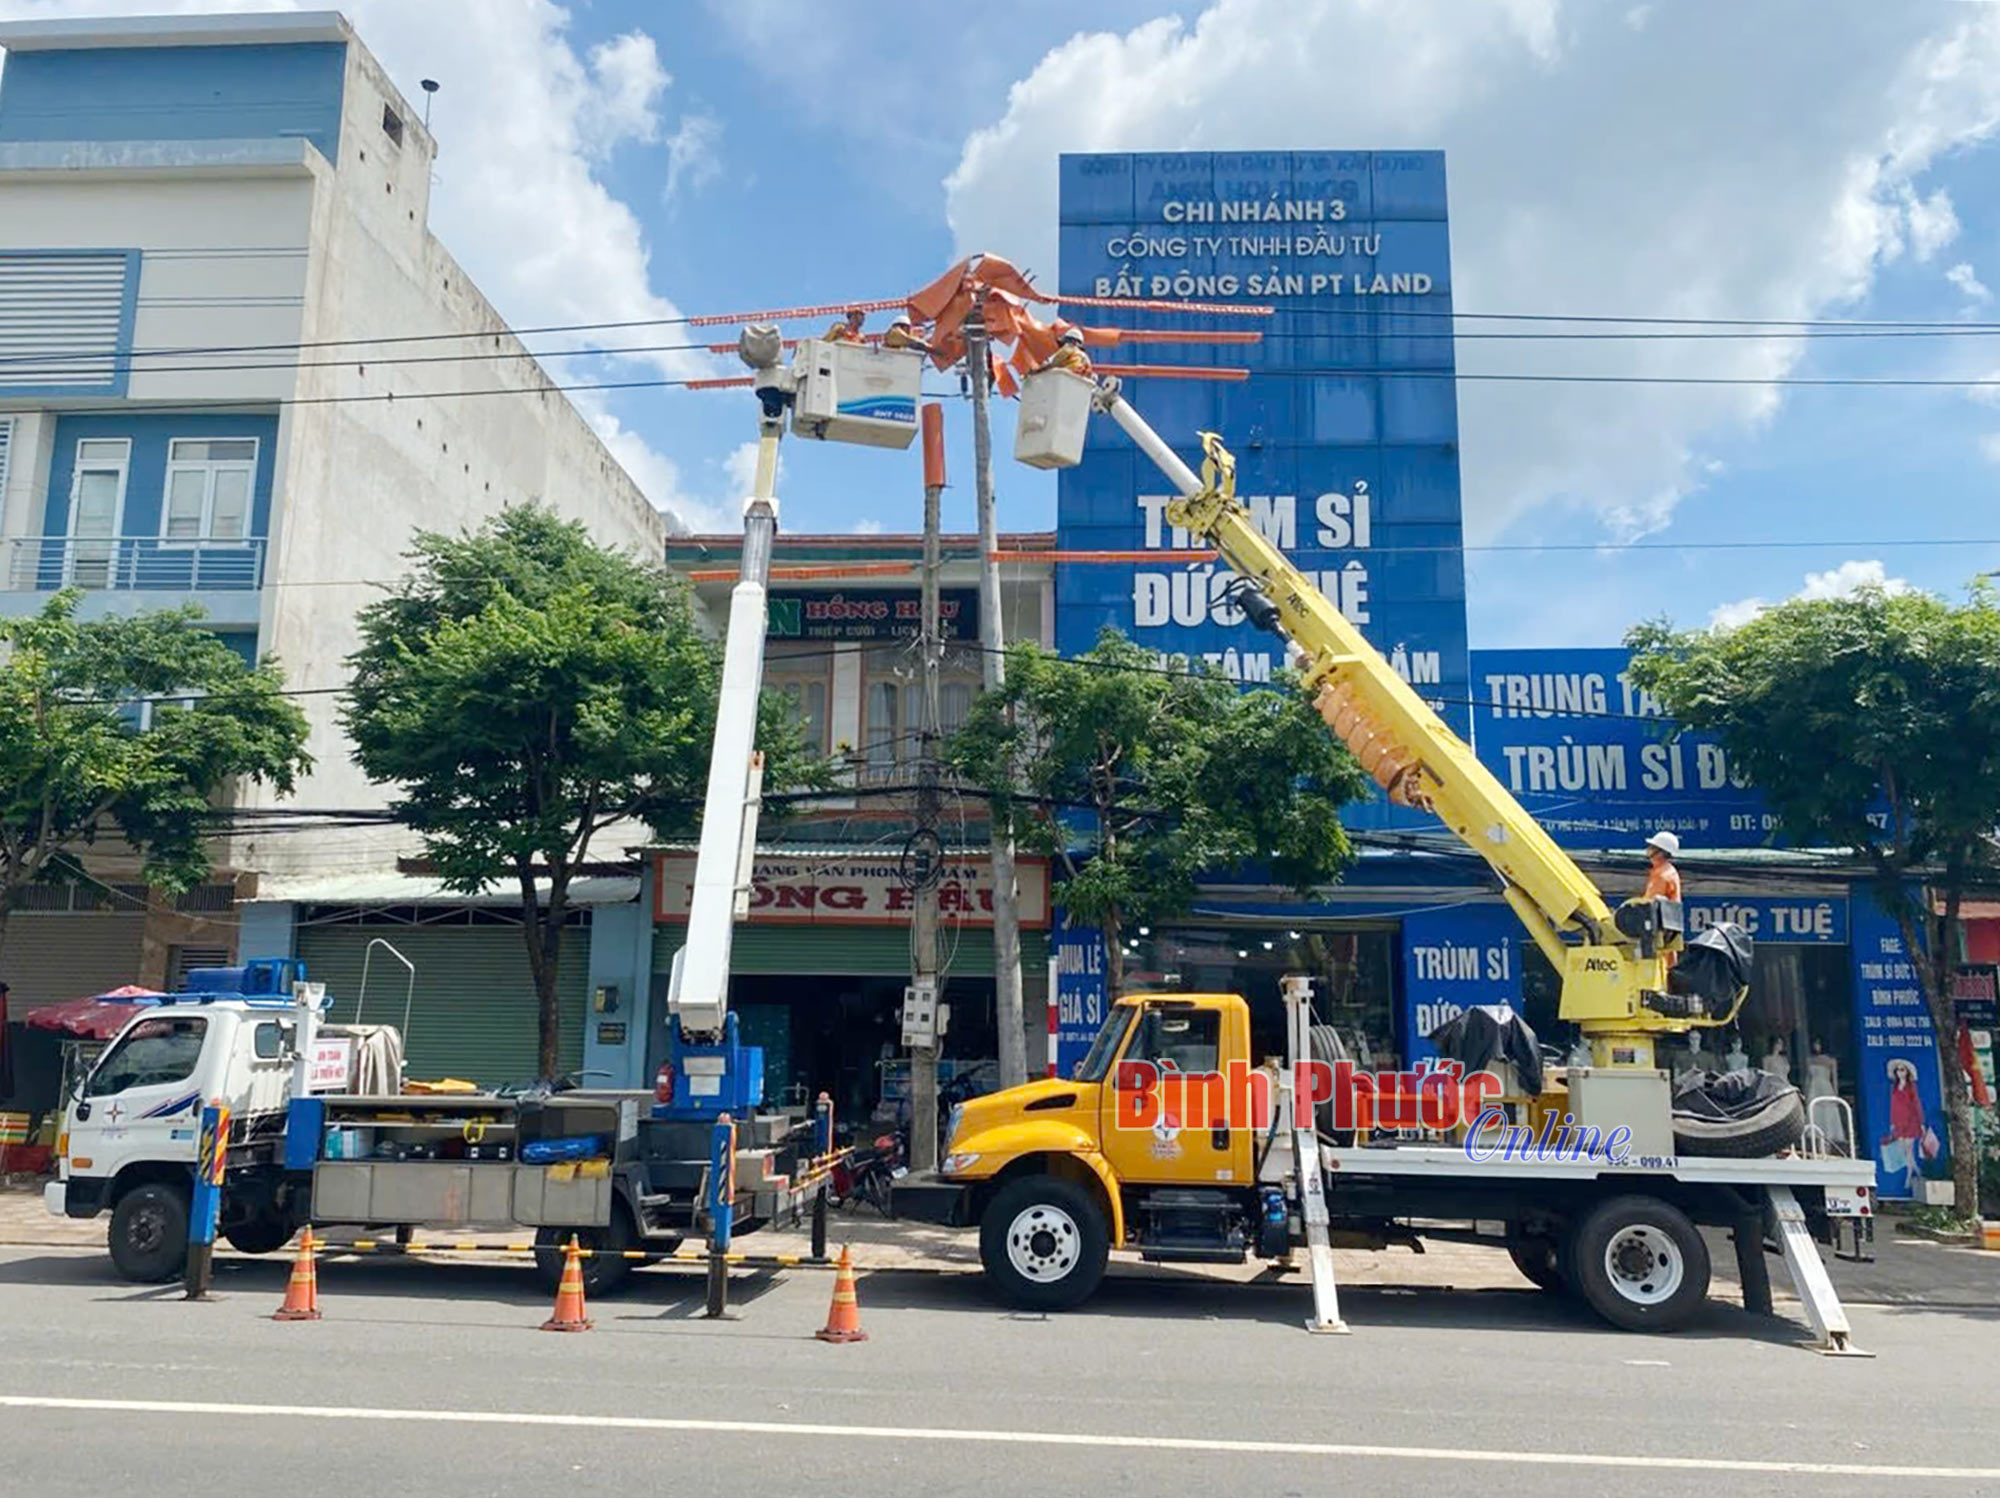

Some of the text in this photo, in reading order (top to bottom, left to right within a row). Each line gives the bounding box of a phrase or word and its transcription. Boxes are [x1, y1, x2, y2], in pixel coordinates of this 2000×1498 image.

[1163, 192, 1346, 223] CHI NHÁNH 3
[1107, 225, 1381, 258] CÔNG TY TNHH ĐẦU TƯ
[1095, 265, 1433, 303] BẤT ĐỘNG SẢN PT LAND
[1315, 481, 1371, 549] SỈ
[806, 593, 889, 619] HỒNG
[1380, 642, 1440, 684] ẮM
[1485, 672, 1607, 719] TRUNG
[1503, 735, 1627, 792] TRÙM
[1729, 814, 1757, 830] ĐT:
[1689, 901, 1835, 940] ĐỨC TUỆ
[1412, 937, 1511, 981] TRÙM SỈ
[1584, 957, 1618, 972] Altec
[1059, 984, 1102, 1024] GIÁ SỈ
